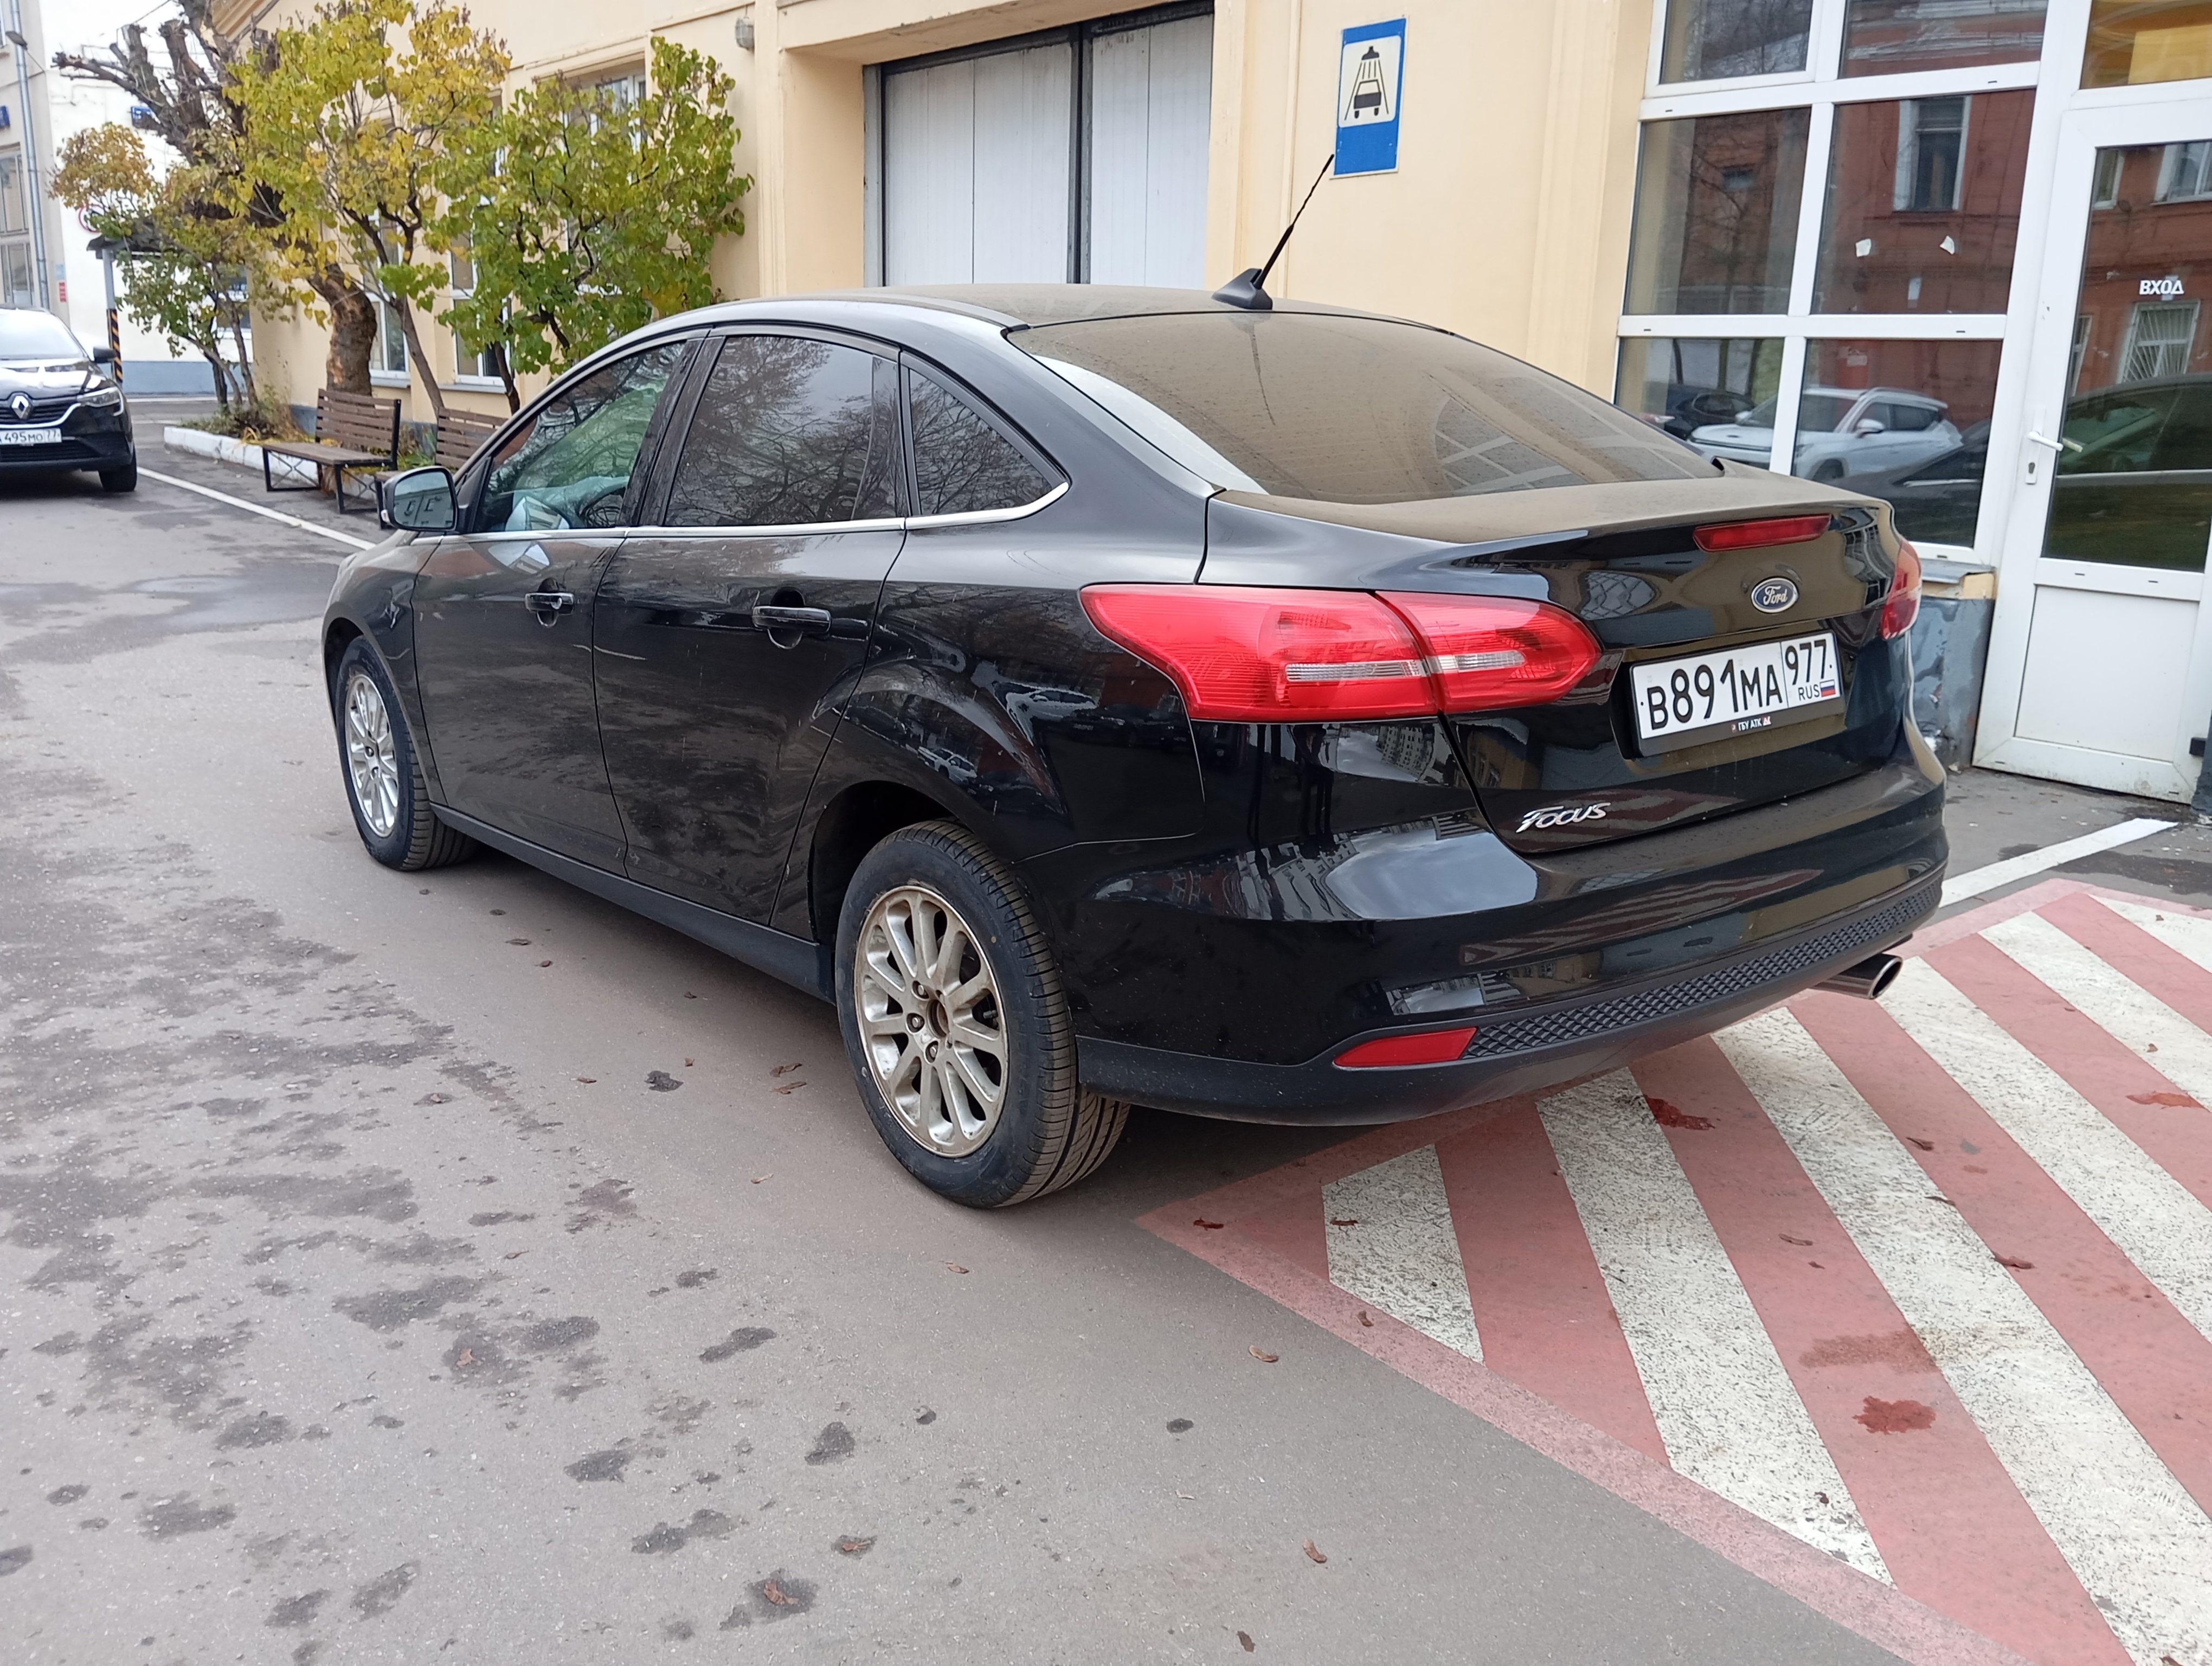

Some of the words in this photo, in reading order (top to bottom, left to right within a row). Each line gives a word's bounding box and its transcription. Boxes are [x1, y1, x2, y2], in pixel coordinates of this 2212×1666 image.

[2139, 279, 2184, 295] ВХОД
[0, 431, 43, 443] 495МО
[1763, 586, 1787, 605] Ford
[1785, 639, 1827, 685] 977
[1798, 685, 1820, 701] RUS
[1738, 720, 1749, 731] ГБУ
[1750, 717, 1762, 729] АТК
